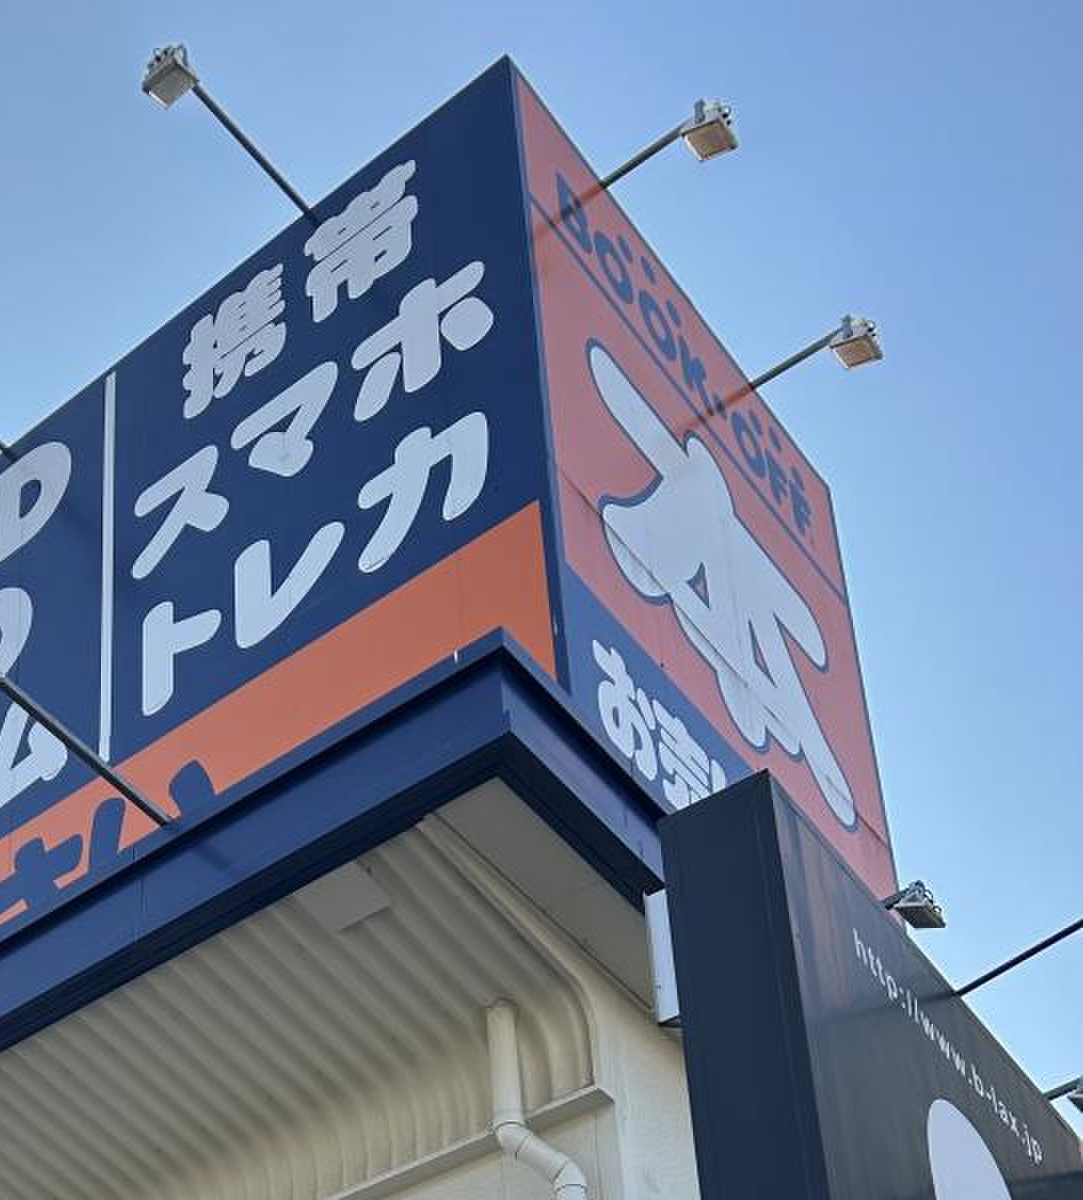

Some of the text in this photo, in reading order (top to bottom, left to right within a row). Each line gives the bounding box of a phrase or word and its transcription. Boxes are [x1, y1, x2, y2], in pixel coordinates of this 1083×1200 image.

[131, 261, 494, 580] スマホ
[182, 159, 418, 419] 携帯
[142, 411, 490, 717] トレカ
[592, 639, 726, 811] お売
